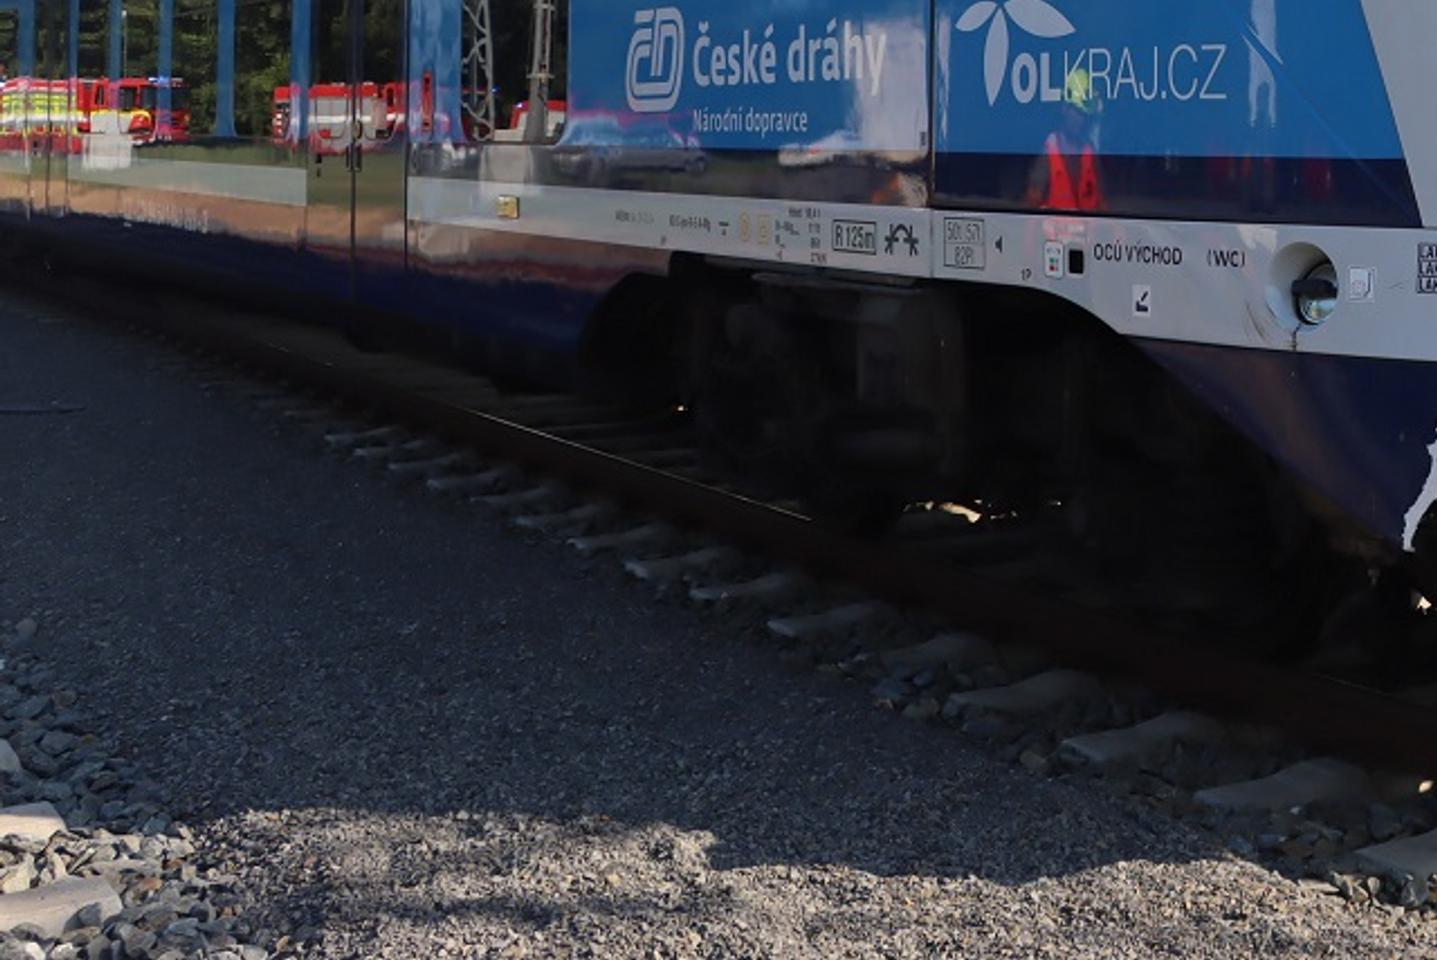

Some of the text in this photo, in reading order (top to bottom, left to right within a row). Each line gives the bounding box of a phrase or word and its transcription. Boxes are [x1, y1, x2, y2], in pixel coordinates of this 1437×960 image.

[693, 17, 887, 96] České dráhy
[1011, 43, 1228, 104] OLKRAJ.CZ
[693, 106, 809, 137] Národní dopravce
[835, 224, 843, 247] R
[846, 225, 874, 249] 125m
[1093, 239, 1246, 268] OCÚ VÝCHOD (WC)
